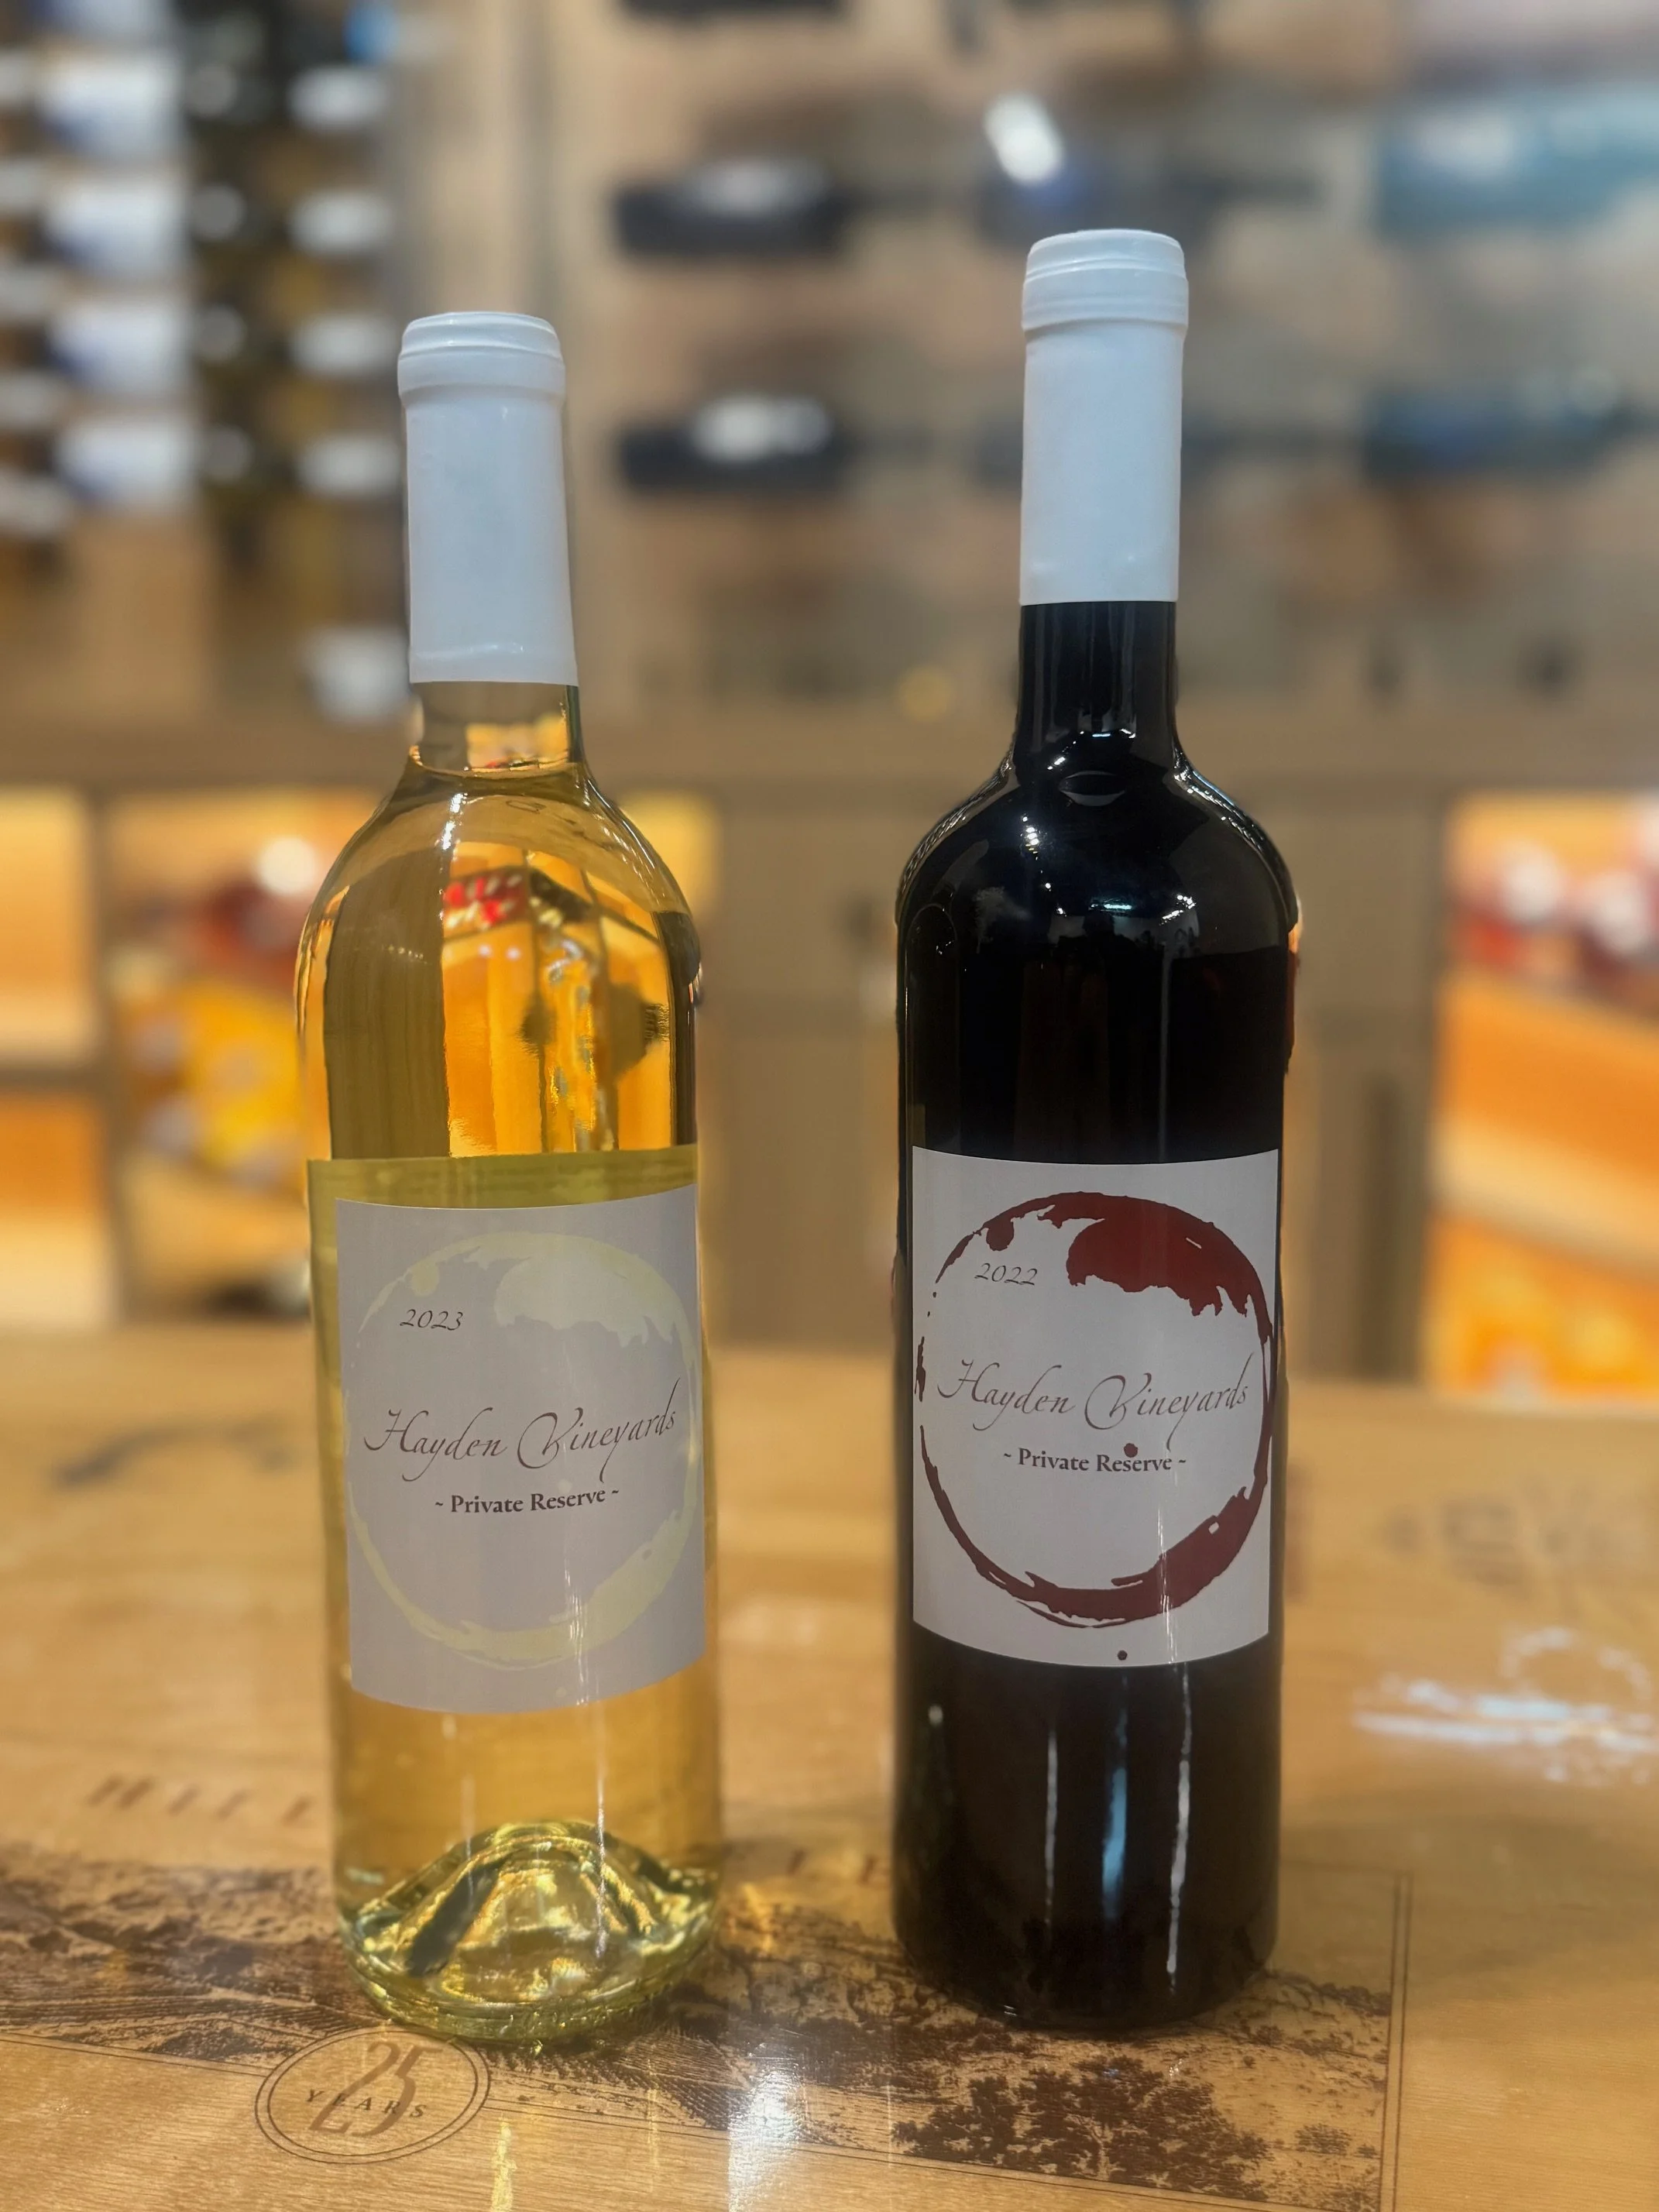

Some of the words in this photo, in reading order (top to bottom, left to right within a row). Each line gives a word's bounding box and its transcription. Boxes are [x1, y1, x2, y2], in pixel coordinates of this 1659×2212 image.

[975, 1262, 1038, 1286] 2022
[400, 1309, 462, 1331] 2023
[938, 1358, 1077, 1431] Hayden
[1084, 1352, 1254, 1451] Vineyards
[363, 1407, 507, 1482] Hayden
[517, 1377, 681, 1483] Vineyards
[1018, 1448, 1090, 1472] Private
[1097, 1454, 1173, 1473] Reserve
[450, 1495, 524, 1513] Private
[531, 1488, 606, 1511] Reserve
